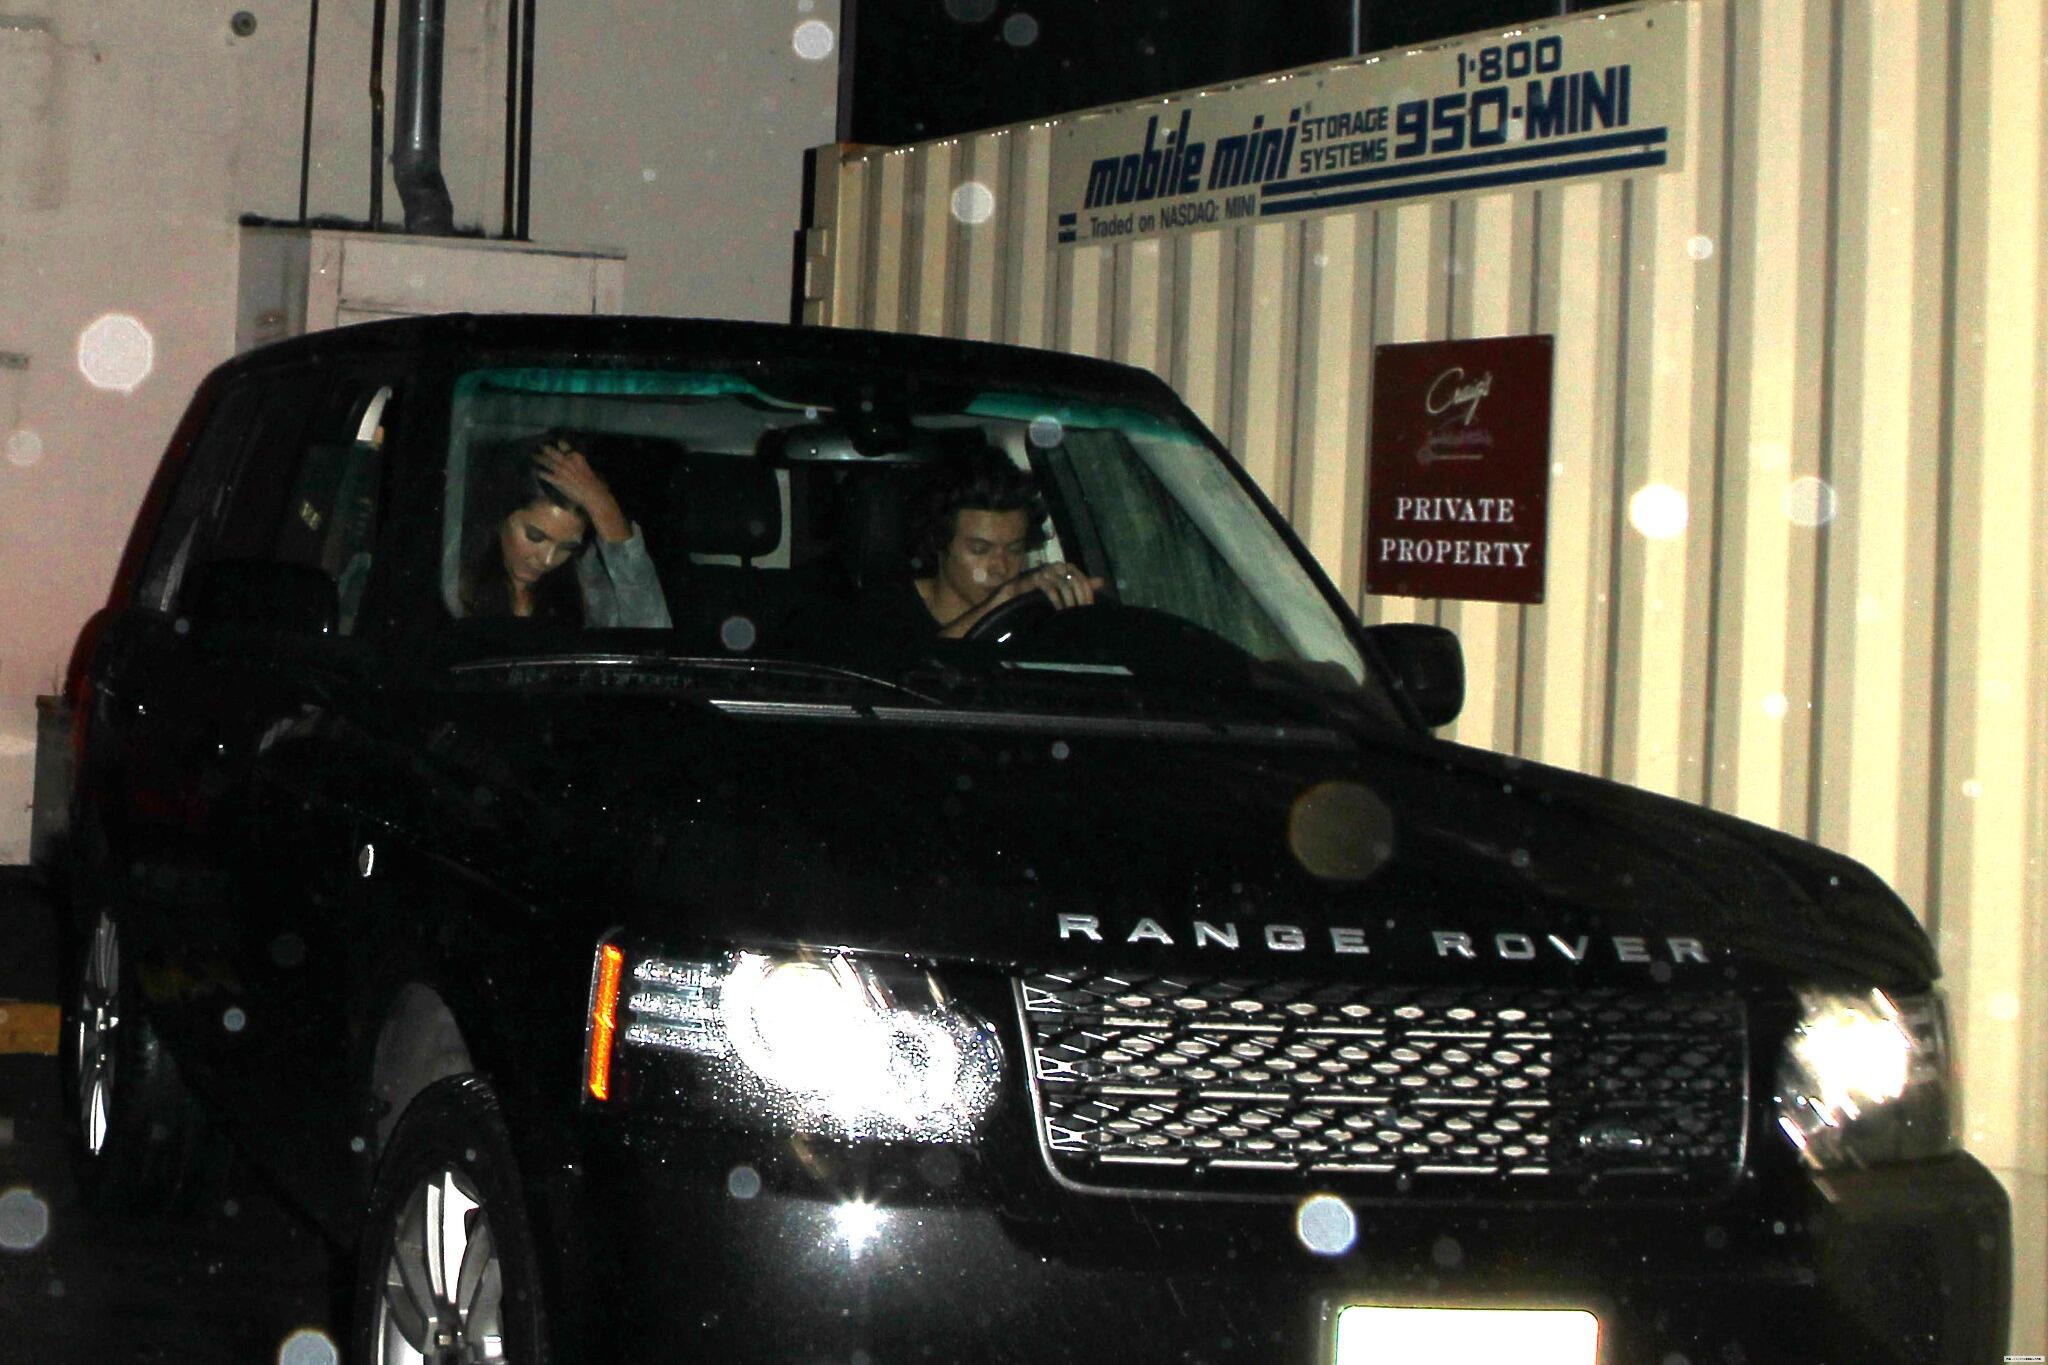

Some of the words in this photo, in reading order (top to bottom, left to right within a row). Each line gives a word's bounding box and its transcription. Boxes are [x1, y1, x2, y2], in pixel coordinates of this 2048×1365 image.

[1301, 106, 1389, 143] STORAGE
[1083, 108, 1206, 209] mobile
[1208, 107, 1302, 190] mini
[1300, 137, 1388, 173] SYSTEMS
[1090, 212, 1133, 238] Traded
[1139, 219, 1156, 233] on
[1160, 198, 1220, 230] NASDAQ:
[1225, 194, 1256, 218] MINI
[1396, 497, 1515, 523] PRIVATE
[1380, 538, 1532, 567] PROPERTY
[1057, 912, 1371, 955] RANGE
[1431, 929, 1710, 963] ROVER
